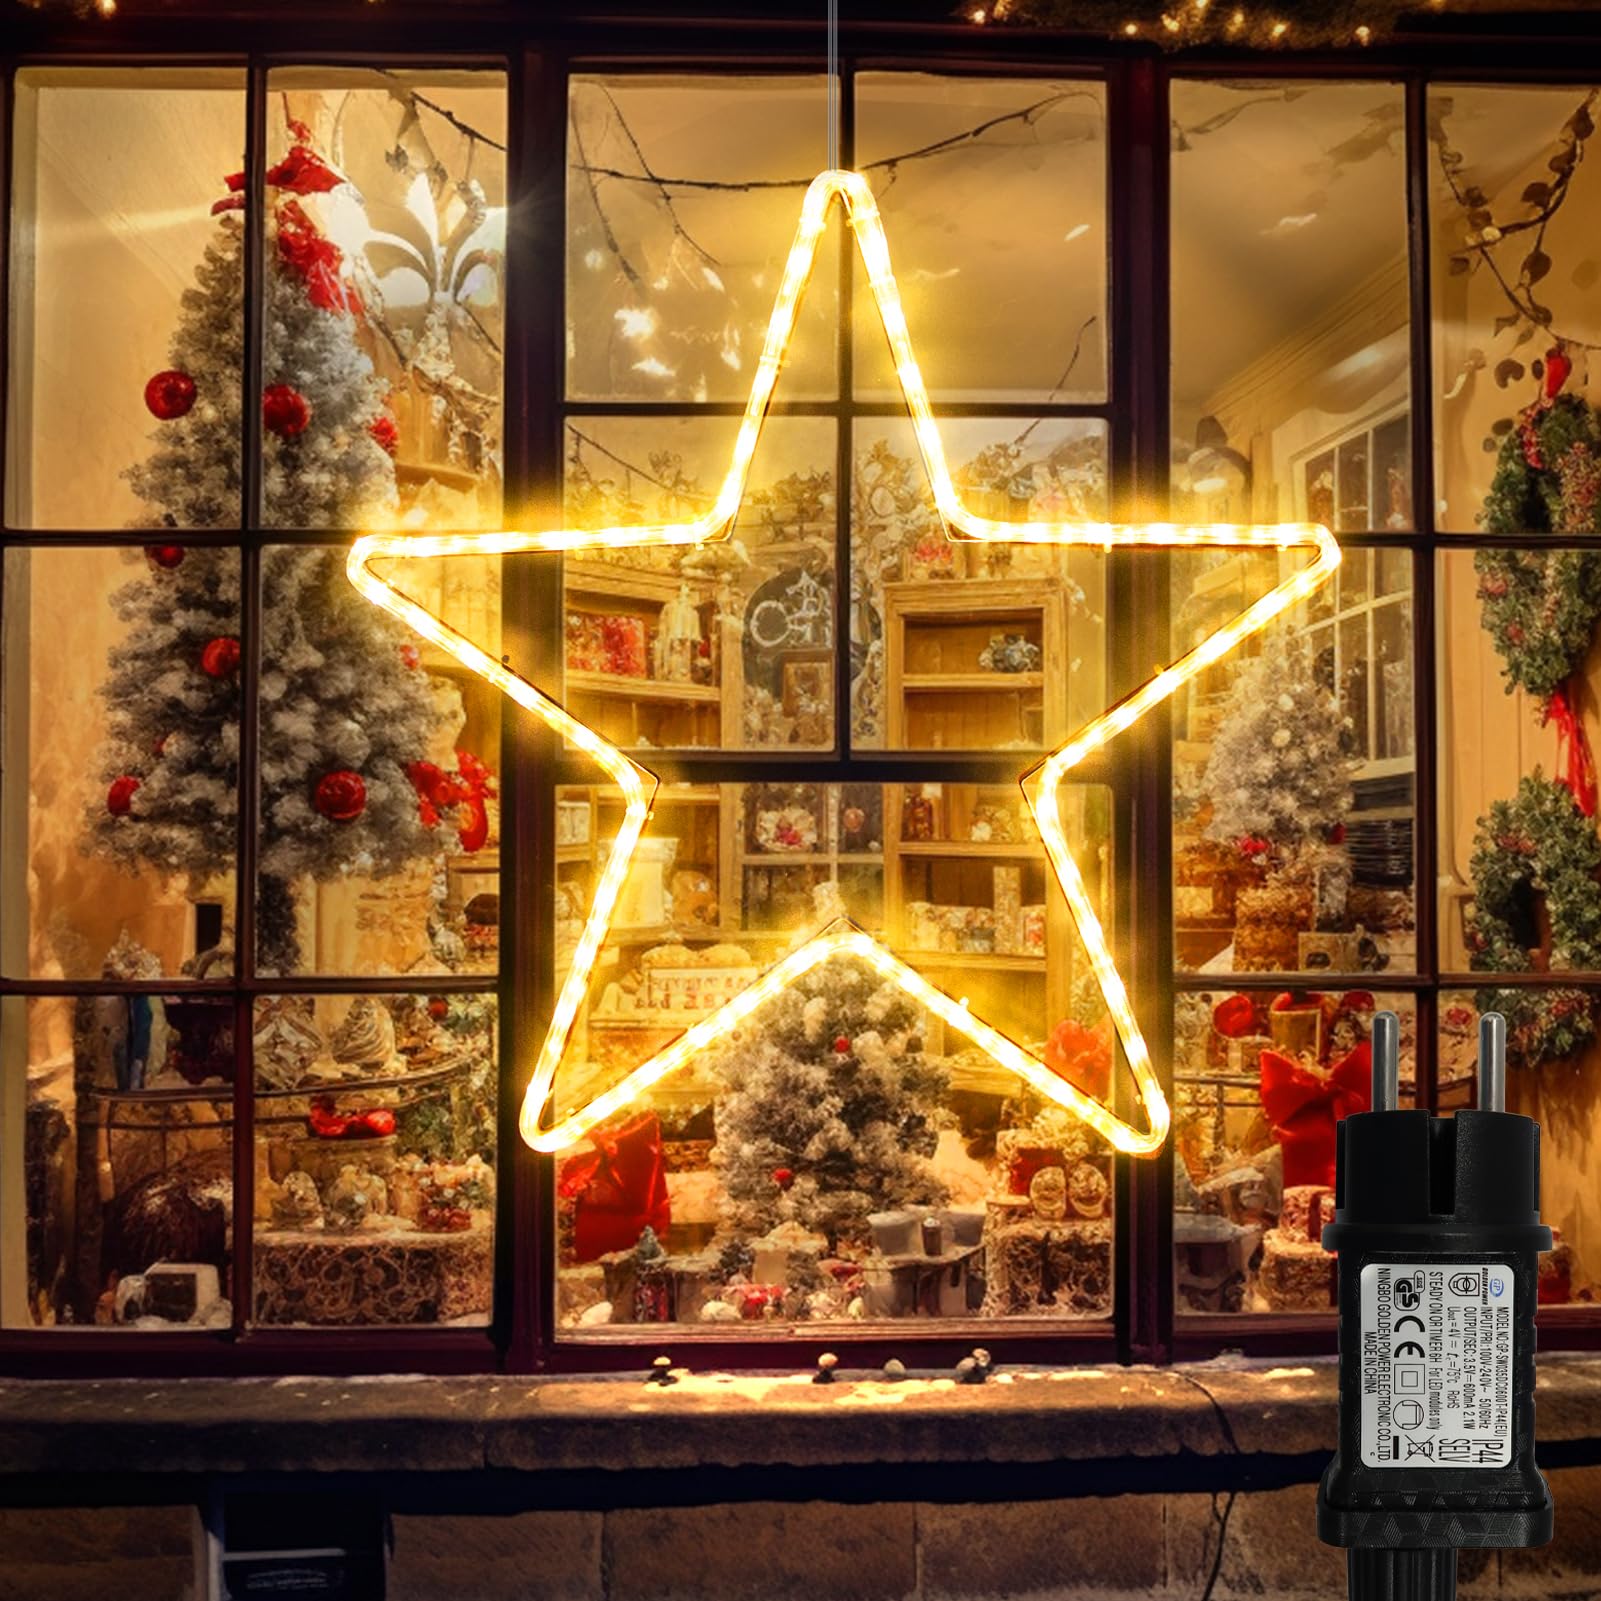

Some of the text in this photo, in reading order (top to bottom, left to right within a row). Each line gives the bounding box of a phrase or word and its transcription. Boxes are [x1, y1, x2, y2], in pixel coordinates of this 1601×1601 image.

[1377, 1268, 1391, 1302] NINGBO
[1377, 1304, 1391, 1340] GOLDEN
[1496, 1307, 1509, 1330] MODEL
[1394, 1316, 1425, 1358] CE
[1426, 1272, 1443, 1430] STEADY ON OR TIMER 6H For LED modules only
[1364, 1332, 1377, 1394] MADE IN CHINA
[1377, 1342, 1391, 1372] POWER
[1377, 1374, 1391, 1427] ELECTRONIC
[1447, 1391, 1460, 1408] RoHS
[1479, 1399, 1491, 1429] 50/60Hz
[1463, 1412, 1475, 1429] 2.1W
[1439, 1439, 1470, 1462] SELV
[1472, 1439, 1504, 1463] IP44
